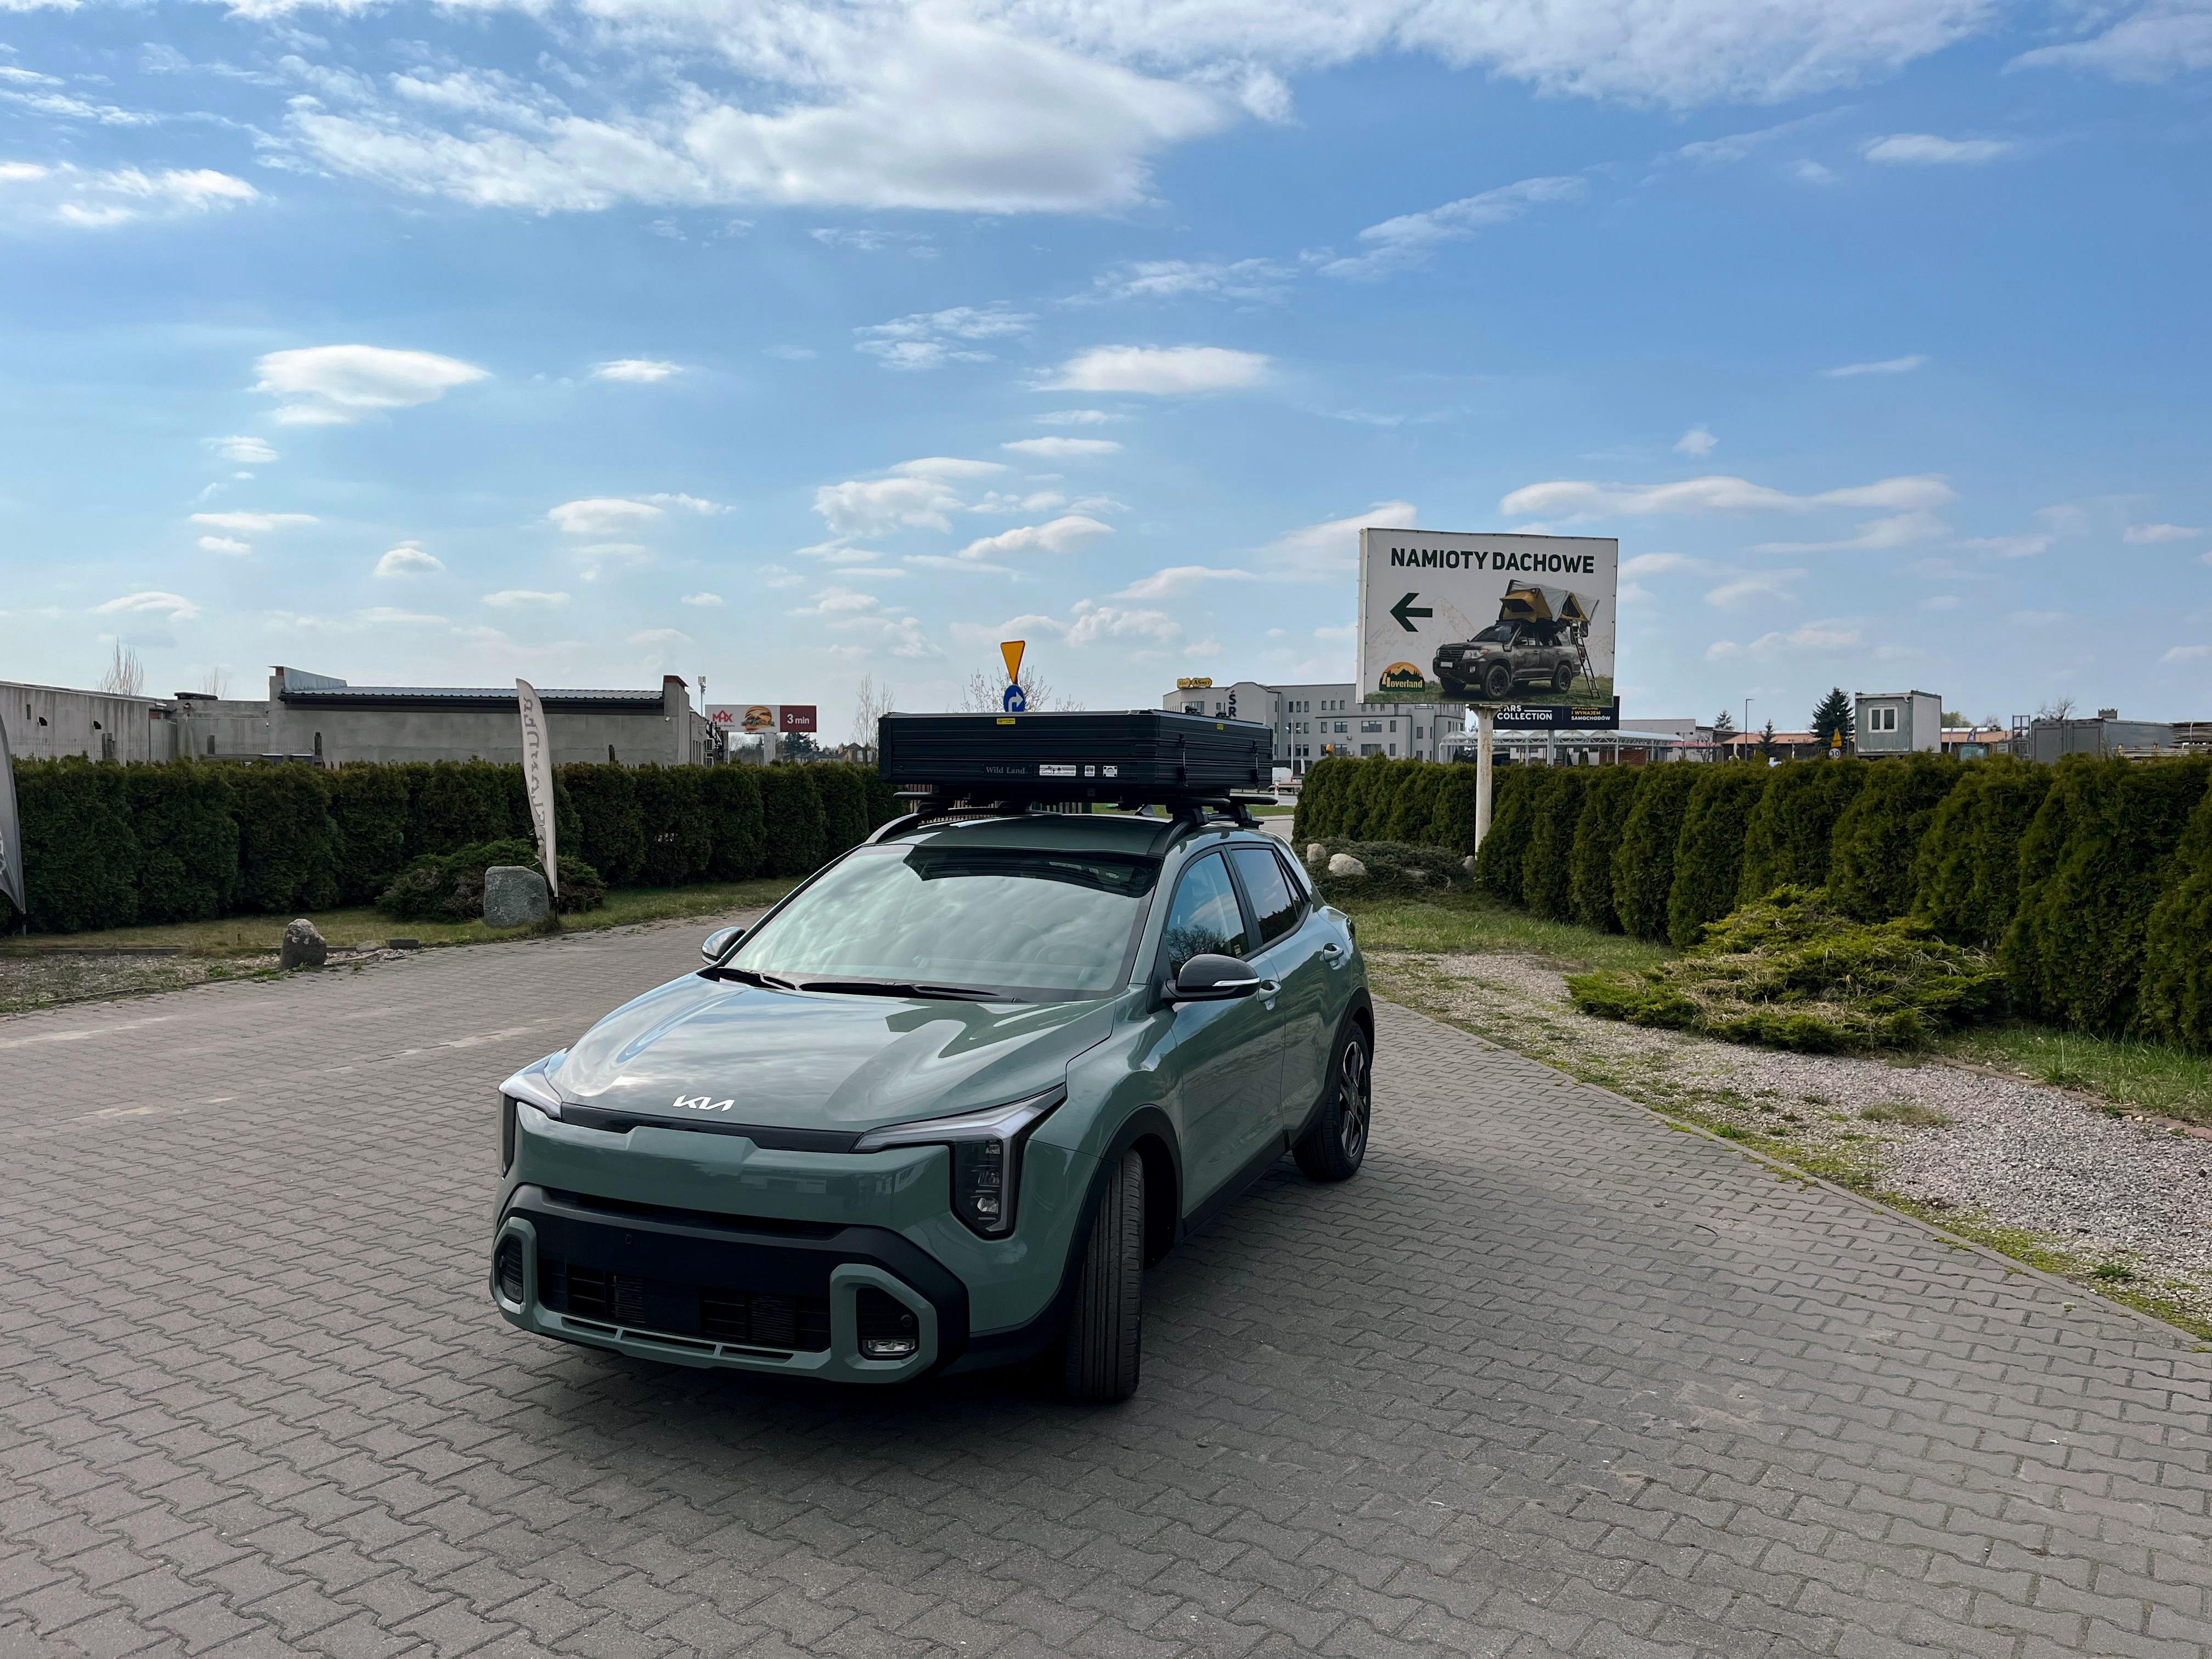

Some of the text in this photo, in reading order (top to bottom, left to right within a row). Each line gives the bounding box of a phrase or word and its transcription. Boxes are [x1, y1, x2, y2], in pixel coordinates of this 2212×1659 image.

[1391, 548, 1594, 574] NAMIOTY DACHOWE
[713, 710, 734, 723] MAX
[787, 714, 794, 725] 3
[1497, 712, 1553, 720] COLLECTION
[673, 1094, 735, 1113] KIA
